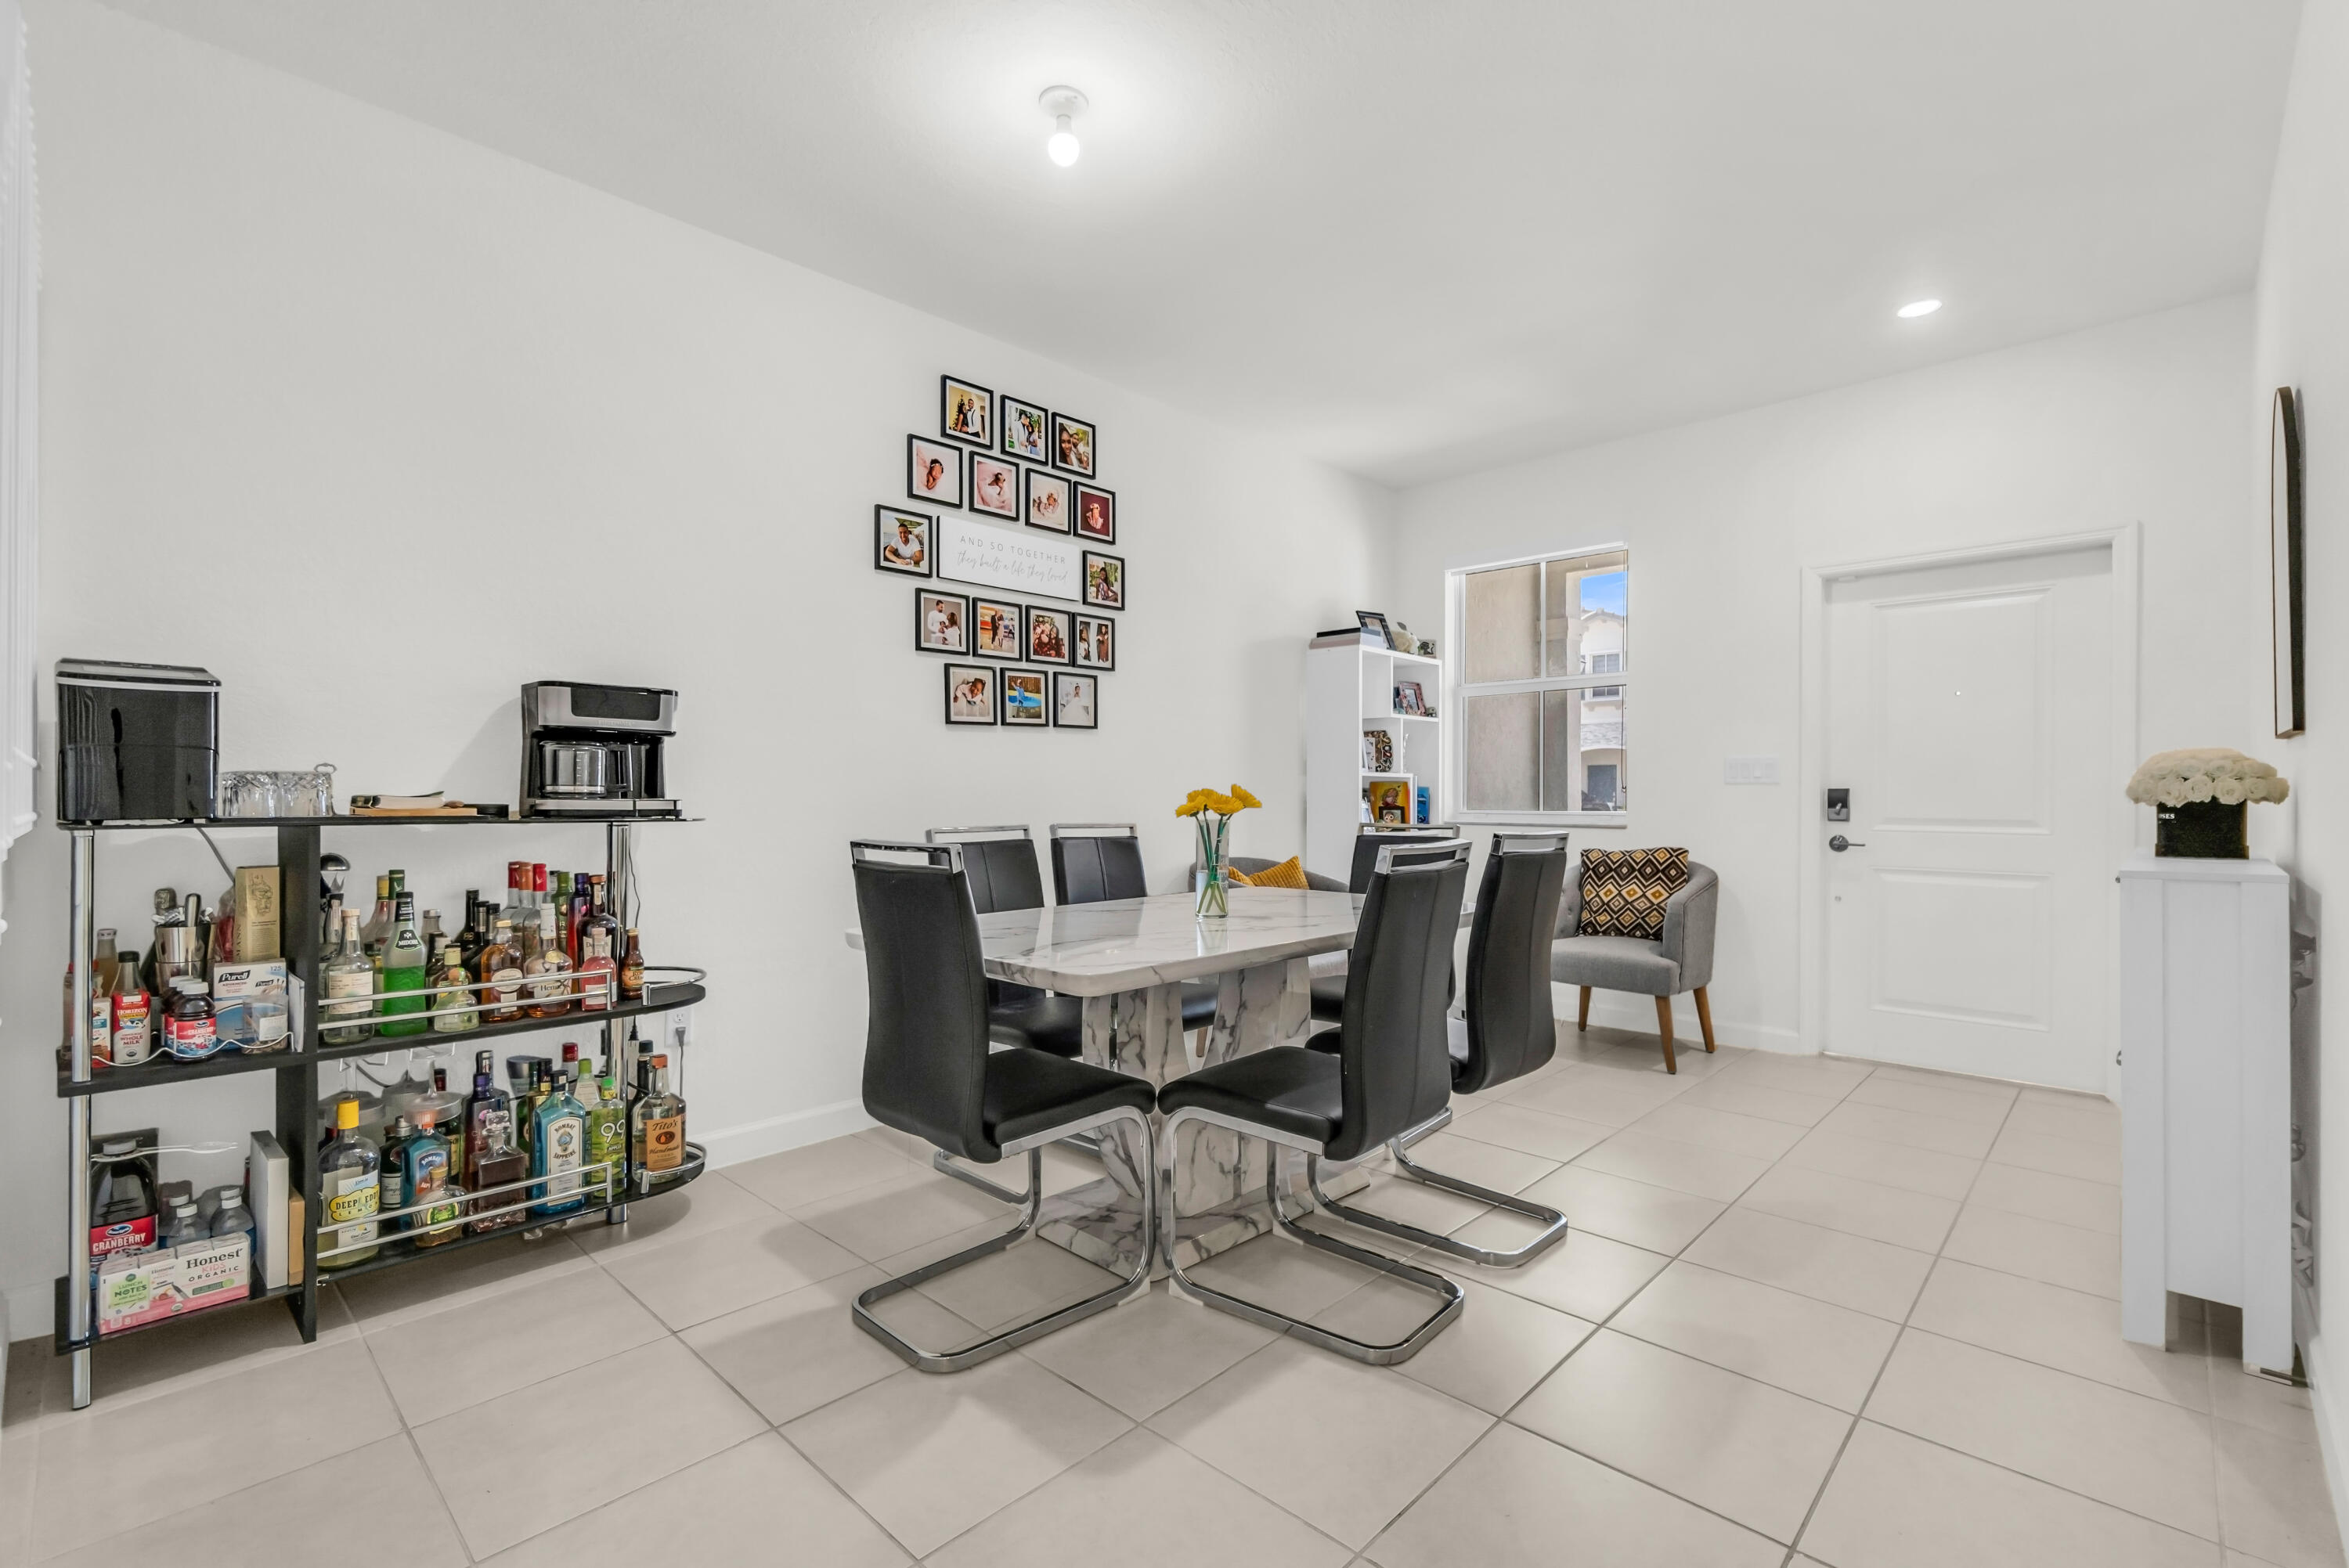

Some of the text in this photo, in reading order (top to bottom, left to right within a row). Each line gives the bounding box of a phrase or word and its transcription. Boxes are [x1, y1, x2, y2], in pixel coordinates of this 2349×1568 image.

[960, 535, 1066, 564] AND SO TOGETHER
[958, 550, 977, 567] they
[980, 553, 1002, 572] built
[1010, 560, 1025, 576] life
[1027, 565, 1046, 582] they
[1047, 568, 1068, 583] loved
[117, 1007, 148, 1016] HORIZON
[601, 1119, 625, 1143] 99
[651, 1119, 678, 1131] Tito's
[335, 1199, 358, 1210] DEEP
[92, 1233, 146, 1252] CRANBERRY
[186, 1248, 240, 1270] Honest
[189, 1265, 239, 1281] ORGANIC
[201, 1262, 226, 1273] KIDS
[114, 1285, 147, 1298] NOTES
[118, 1280, 143, 1290] LUNCH
